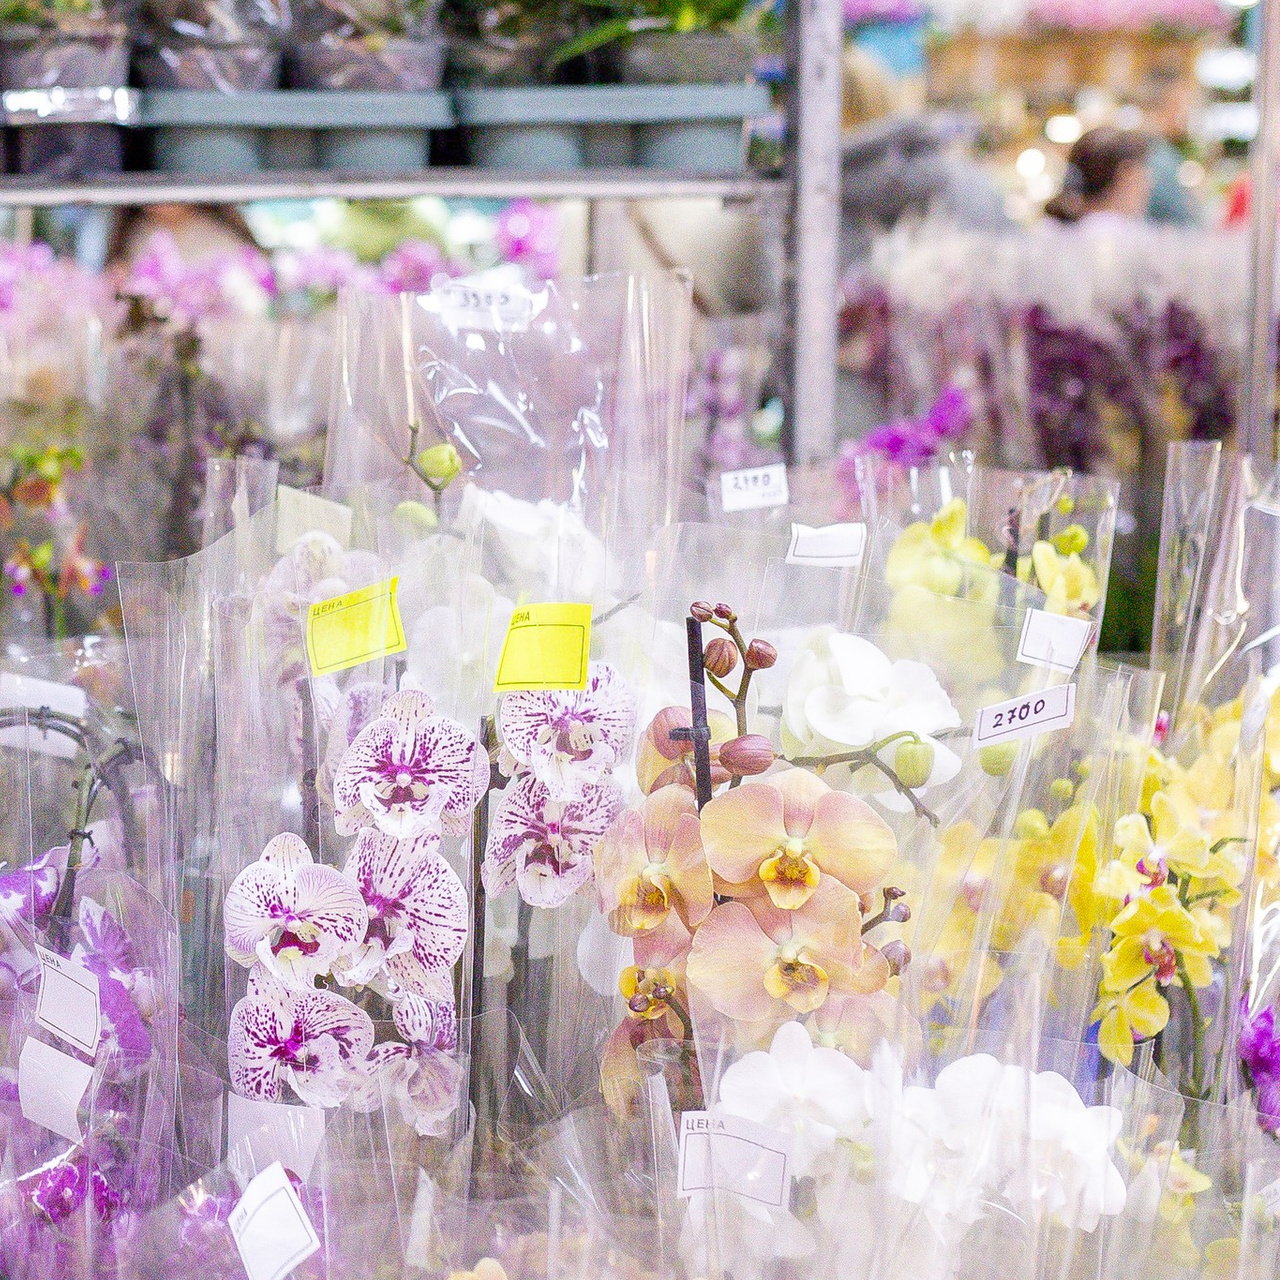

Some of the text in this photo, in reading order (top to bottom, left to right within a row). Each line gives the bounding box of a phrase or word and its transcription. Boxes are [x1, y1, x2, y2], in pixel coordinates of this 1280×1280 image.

[312, 599, 343, 616] ЦЕНА
[991, 698, 1046, 729] 2700
[38, 950, 62, 970] ЦЕНА
